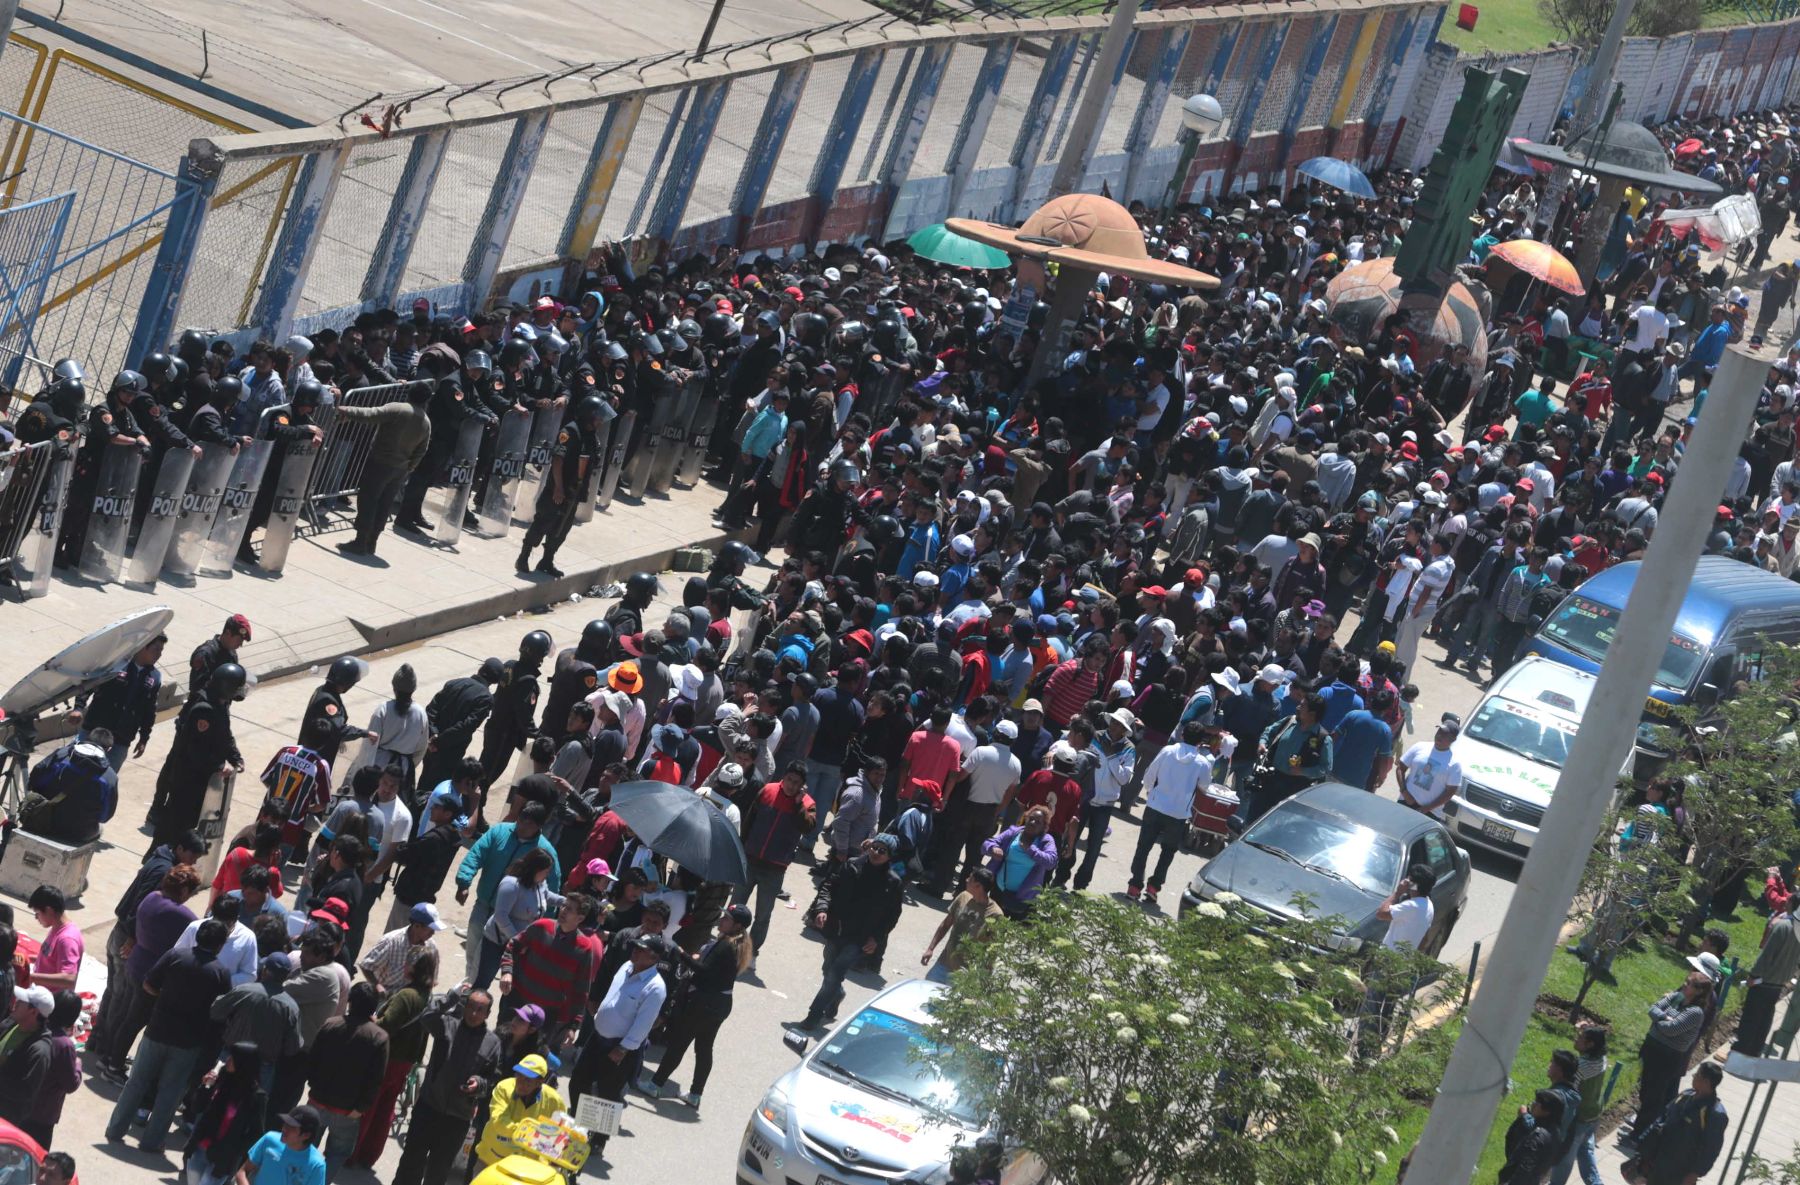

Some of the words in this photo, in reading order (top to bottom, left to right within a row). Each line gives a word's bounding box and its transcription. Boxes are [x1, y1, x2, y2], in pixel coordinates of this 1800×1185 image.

[285, 755, 311, 770] UNCP
[274, 769, 304, 800] 17
[841, 1112, 913, 1143] HORAS
